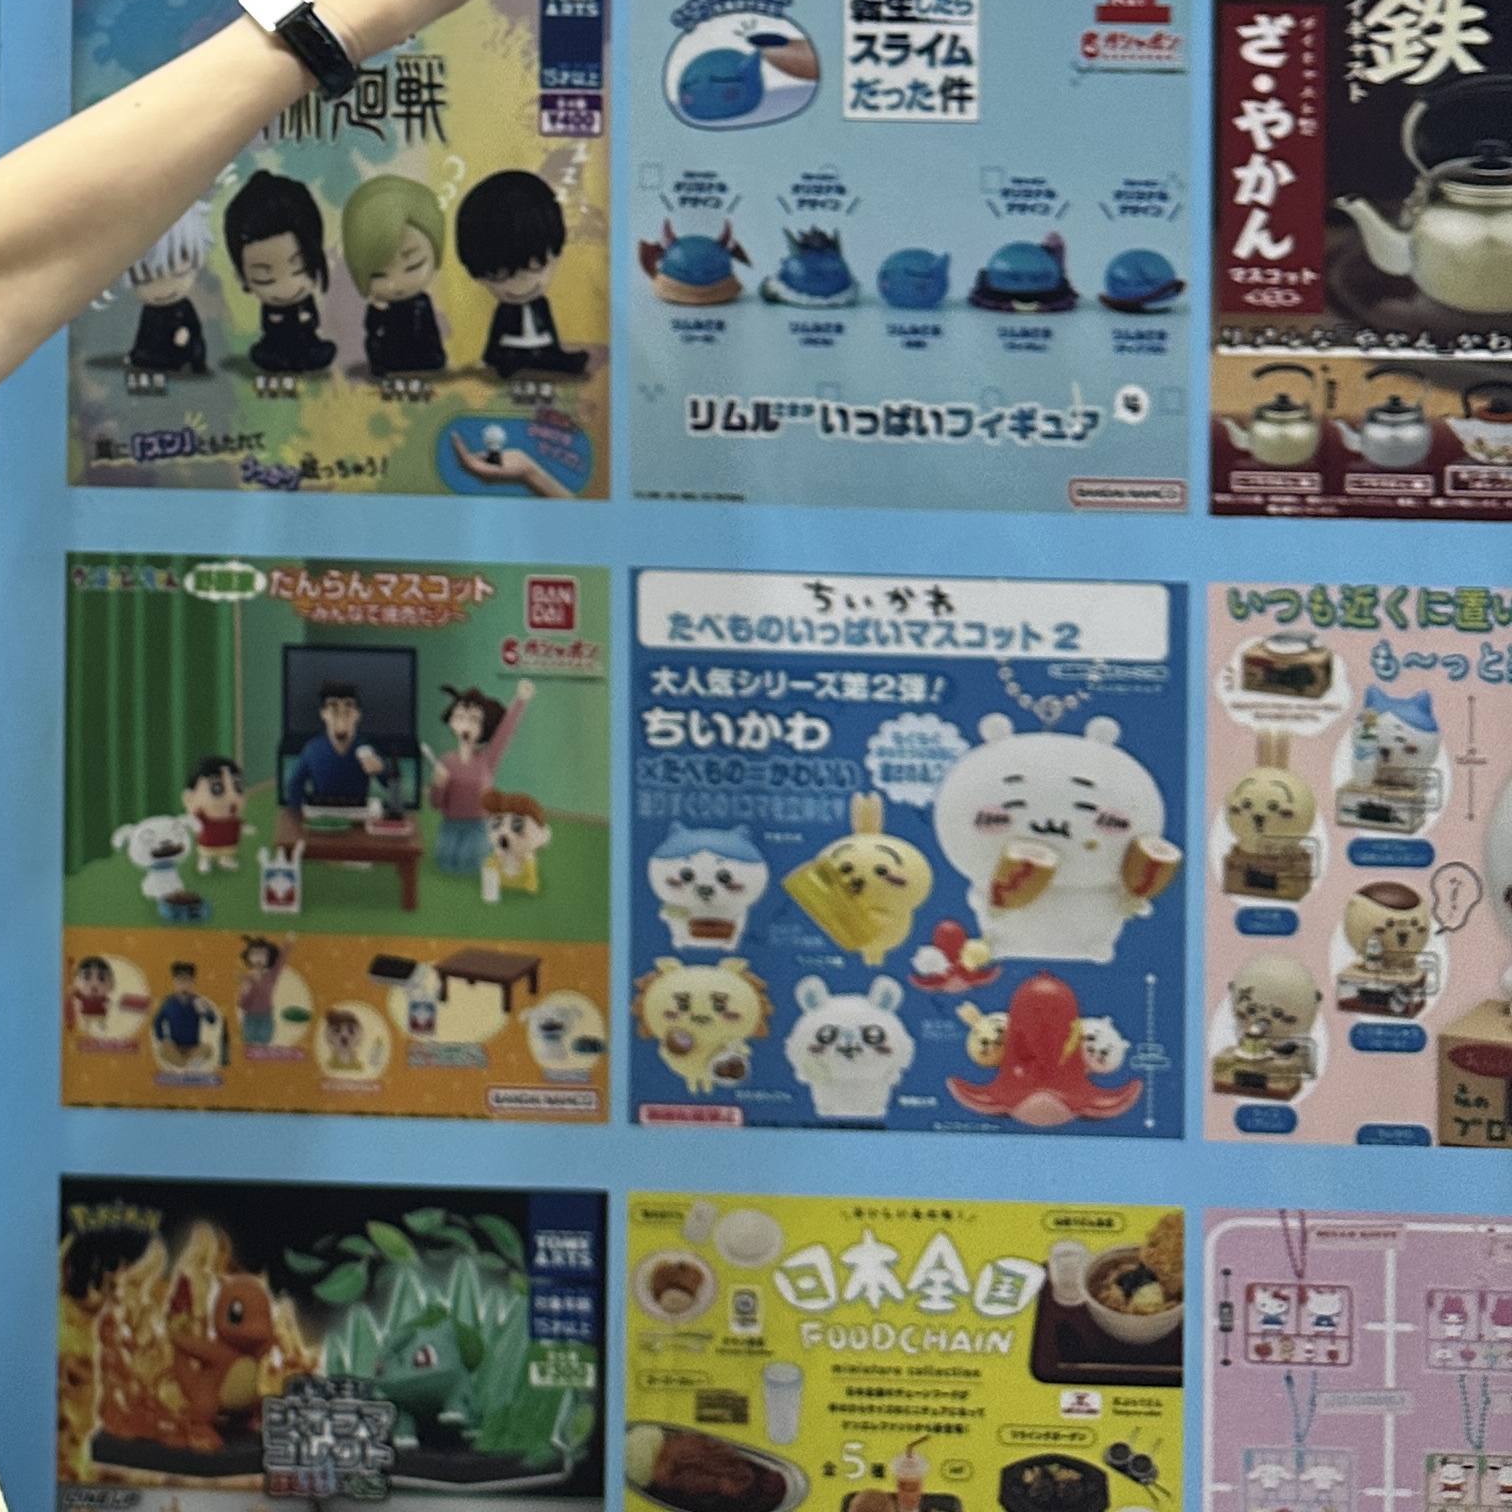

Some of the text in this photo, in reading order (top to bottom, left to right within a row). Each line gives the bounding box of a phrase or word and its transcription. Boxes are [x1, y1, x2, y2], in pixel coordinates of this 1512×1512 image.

[545, 4, 599, 17] ARTS
[850, 33, 973, 67] スライム
[850, 76, 973, 113] だった件
[1232, 13, 1296, 261] ざ・やかん
[1228, 267, 1320, 285] マスコット
[804, 579, 955, 616] ちいかわ
[666, 610, 1081, 651] たべものいっぱいマスコット 2
[1371, 639, 1512, 683] も〜っと
[649, 666, 947, 704] 大人気シリーズ第2弾!
[642, 705, 832, 752] ちいかわ
